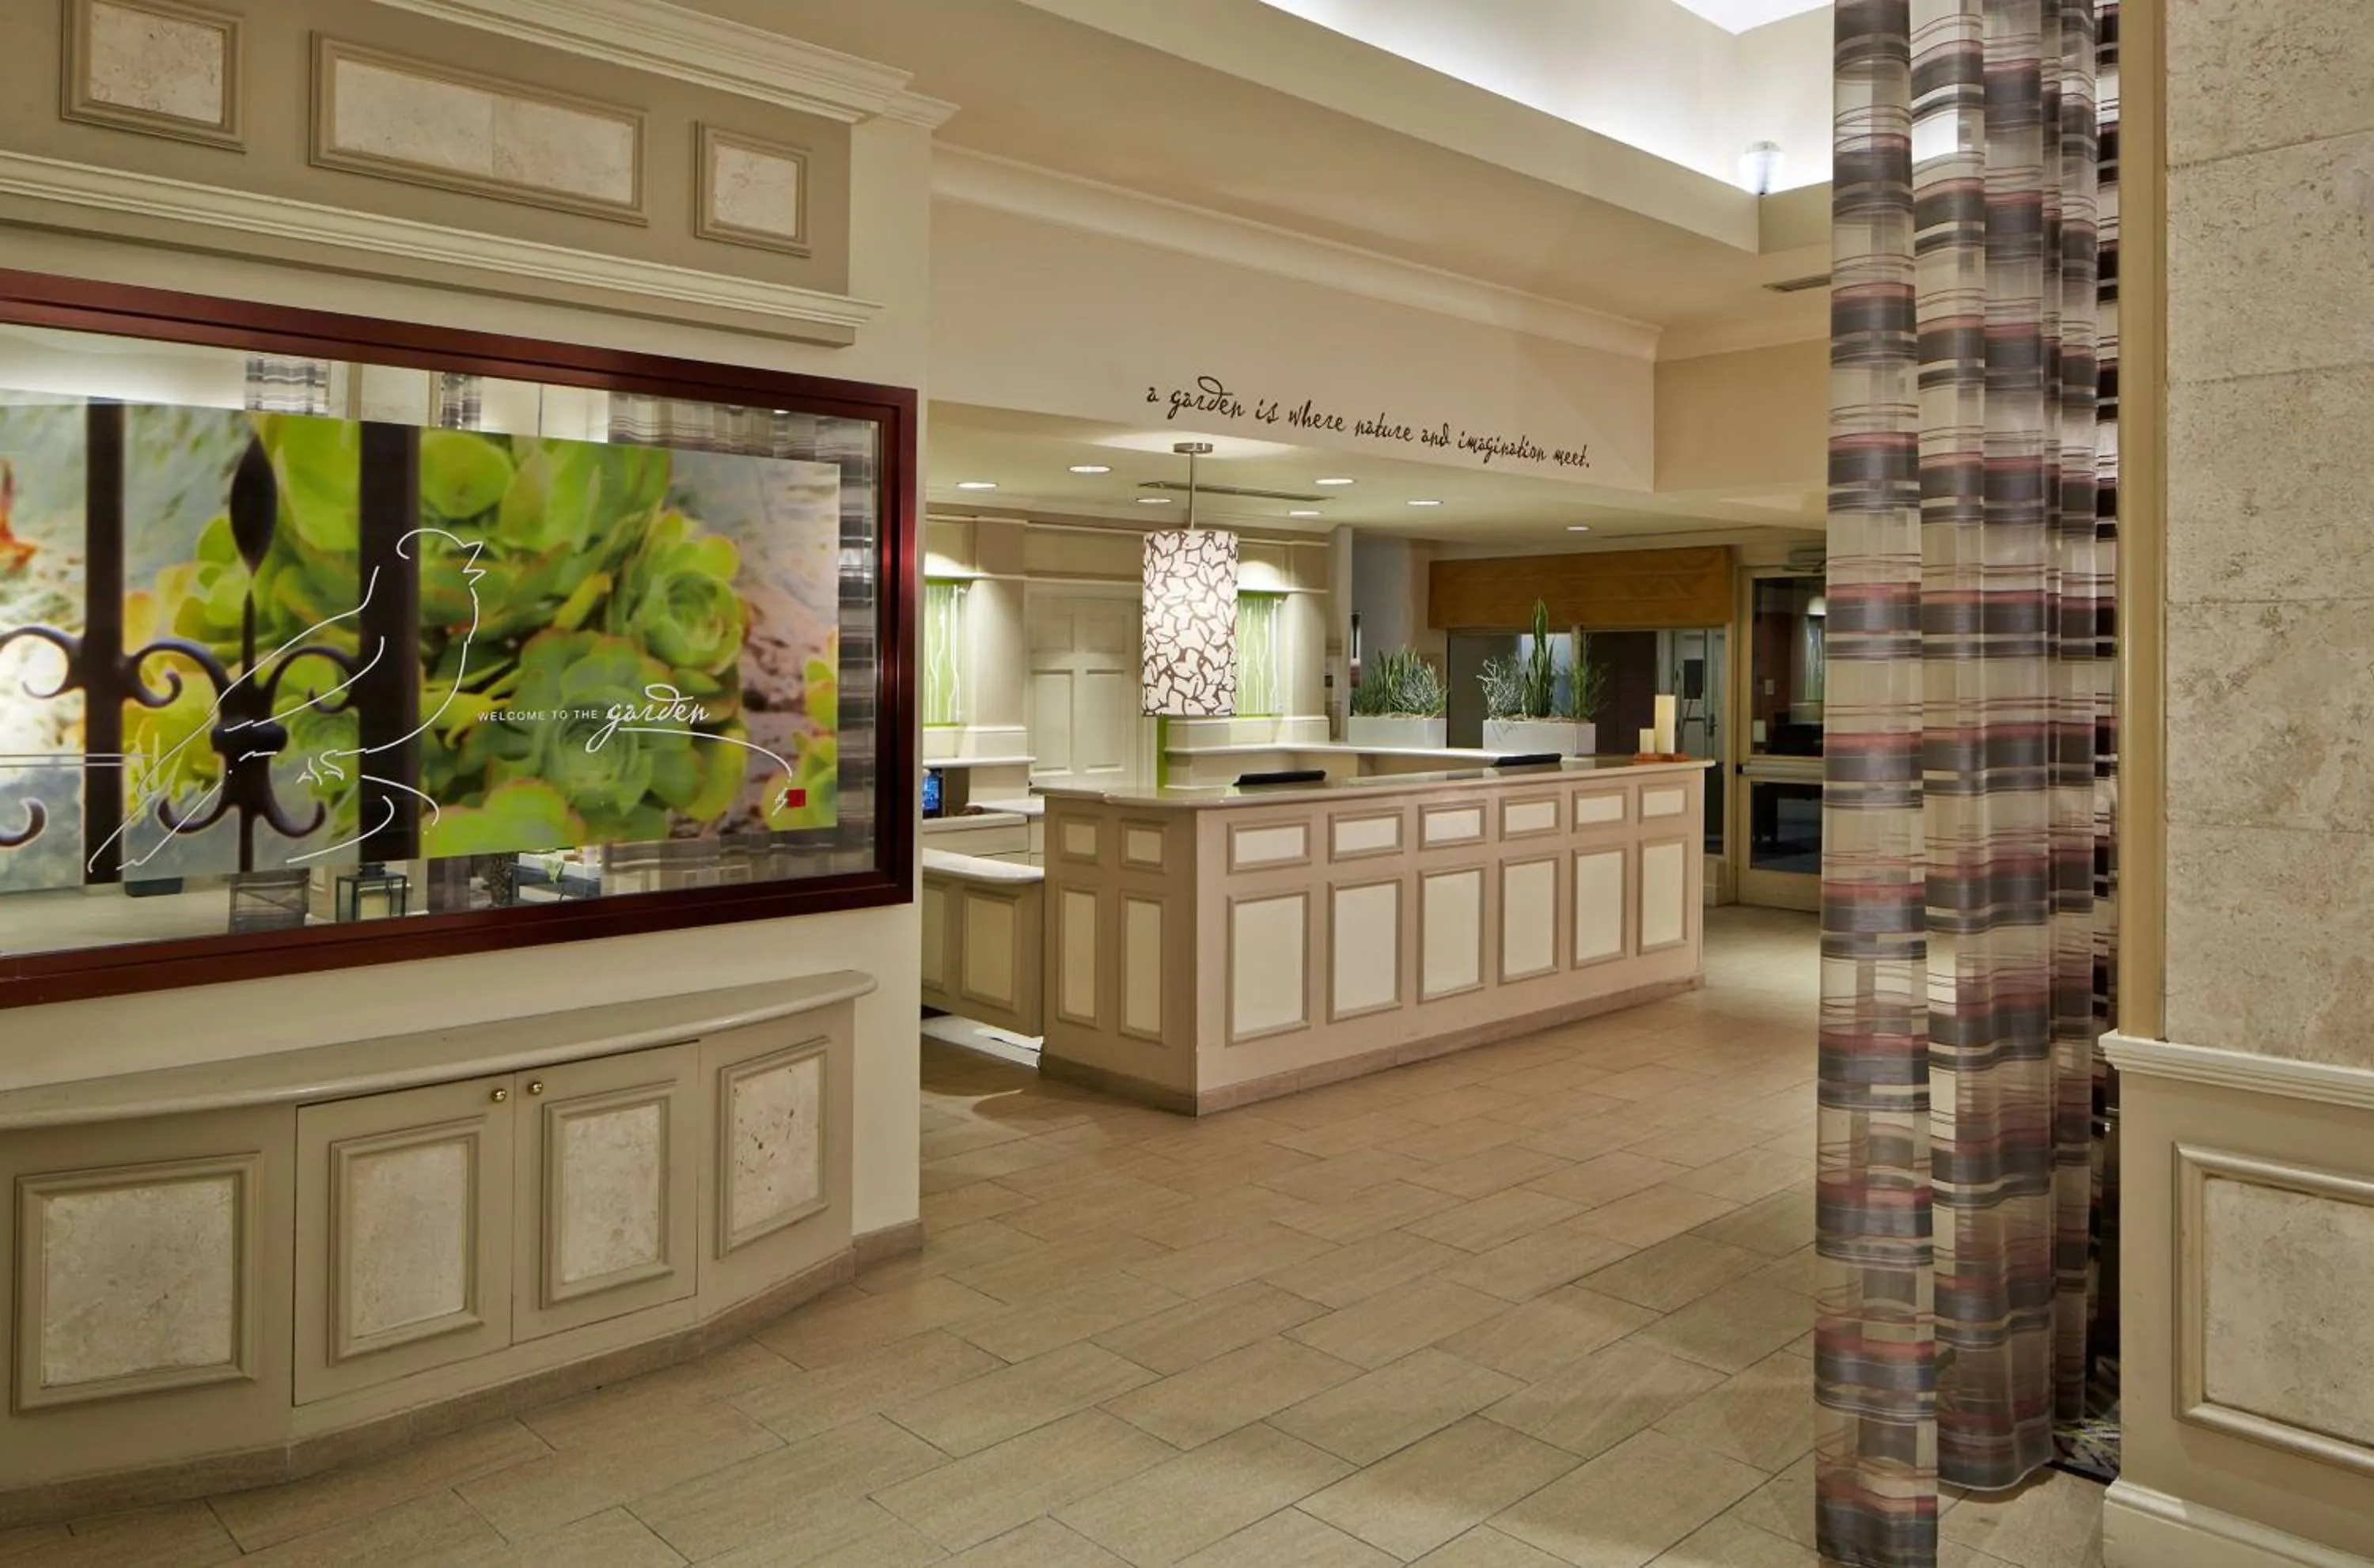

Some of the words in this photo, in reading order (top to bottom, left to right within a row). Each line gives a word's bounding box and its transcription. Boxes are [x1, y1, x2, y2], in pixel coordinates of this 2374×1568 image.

[1147, 387, 1159, 403] a
[1166, 376, 1245, 420] garden
[1254, 399, 1279, 424] is
[1288, 400, 1346, 432] where
[1354, 412, 1413, 442] nature
[1421, 422, 1450, 447] and
[1458, 430, 1546, 464] imagination
[1553, 444, 1590, 469] meet.
[478, 710, 545, 722] WELCOME
[552, 710, 567, 720] TO
[575, 710, 597, 719] THE
[585, 683, 710, 754] garden
